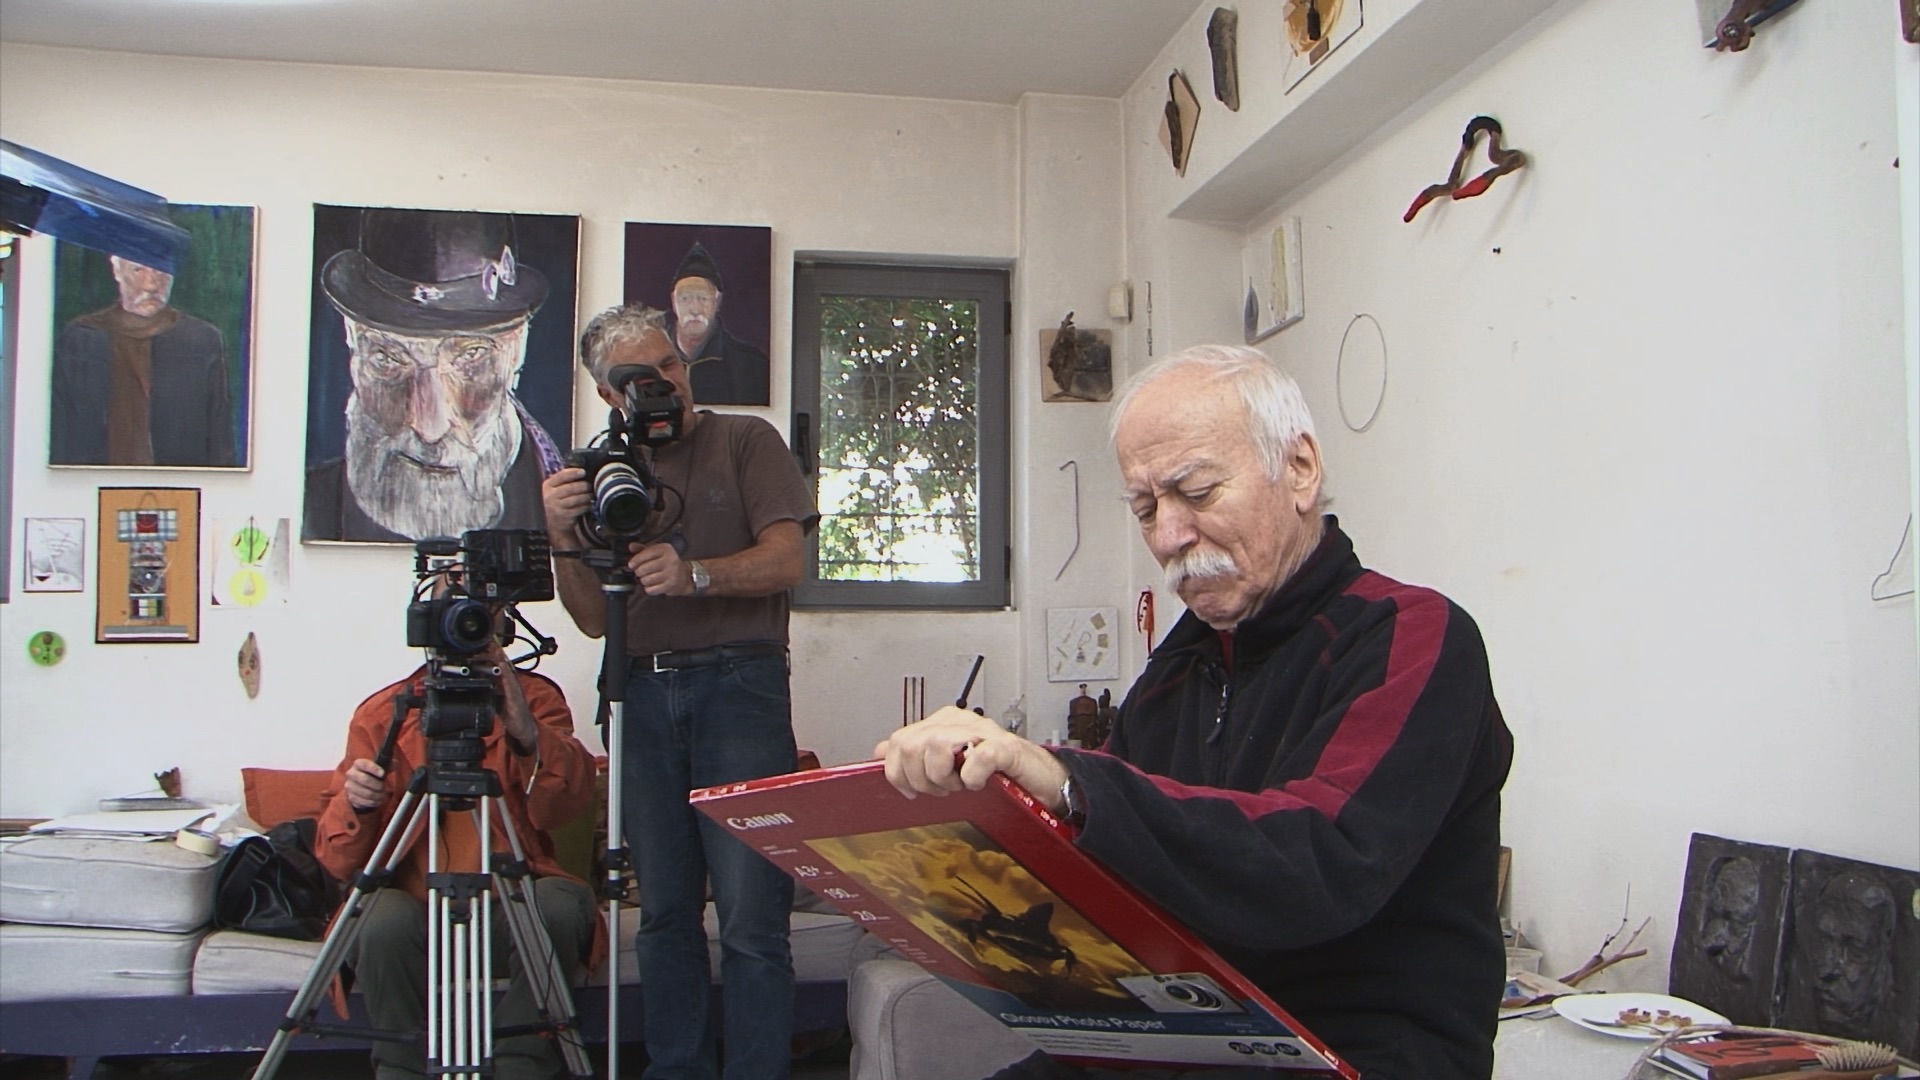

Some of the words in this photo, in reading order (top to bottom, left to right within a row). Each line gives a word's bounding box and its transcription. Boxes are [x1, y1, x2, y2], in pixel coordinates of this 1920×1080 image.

[726, 812, 794, 831] Canon
[1055, 1015, 1111, 1028] Photo
[1108, 1017, 1167, 1031] Paper
